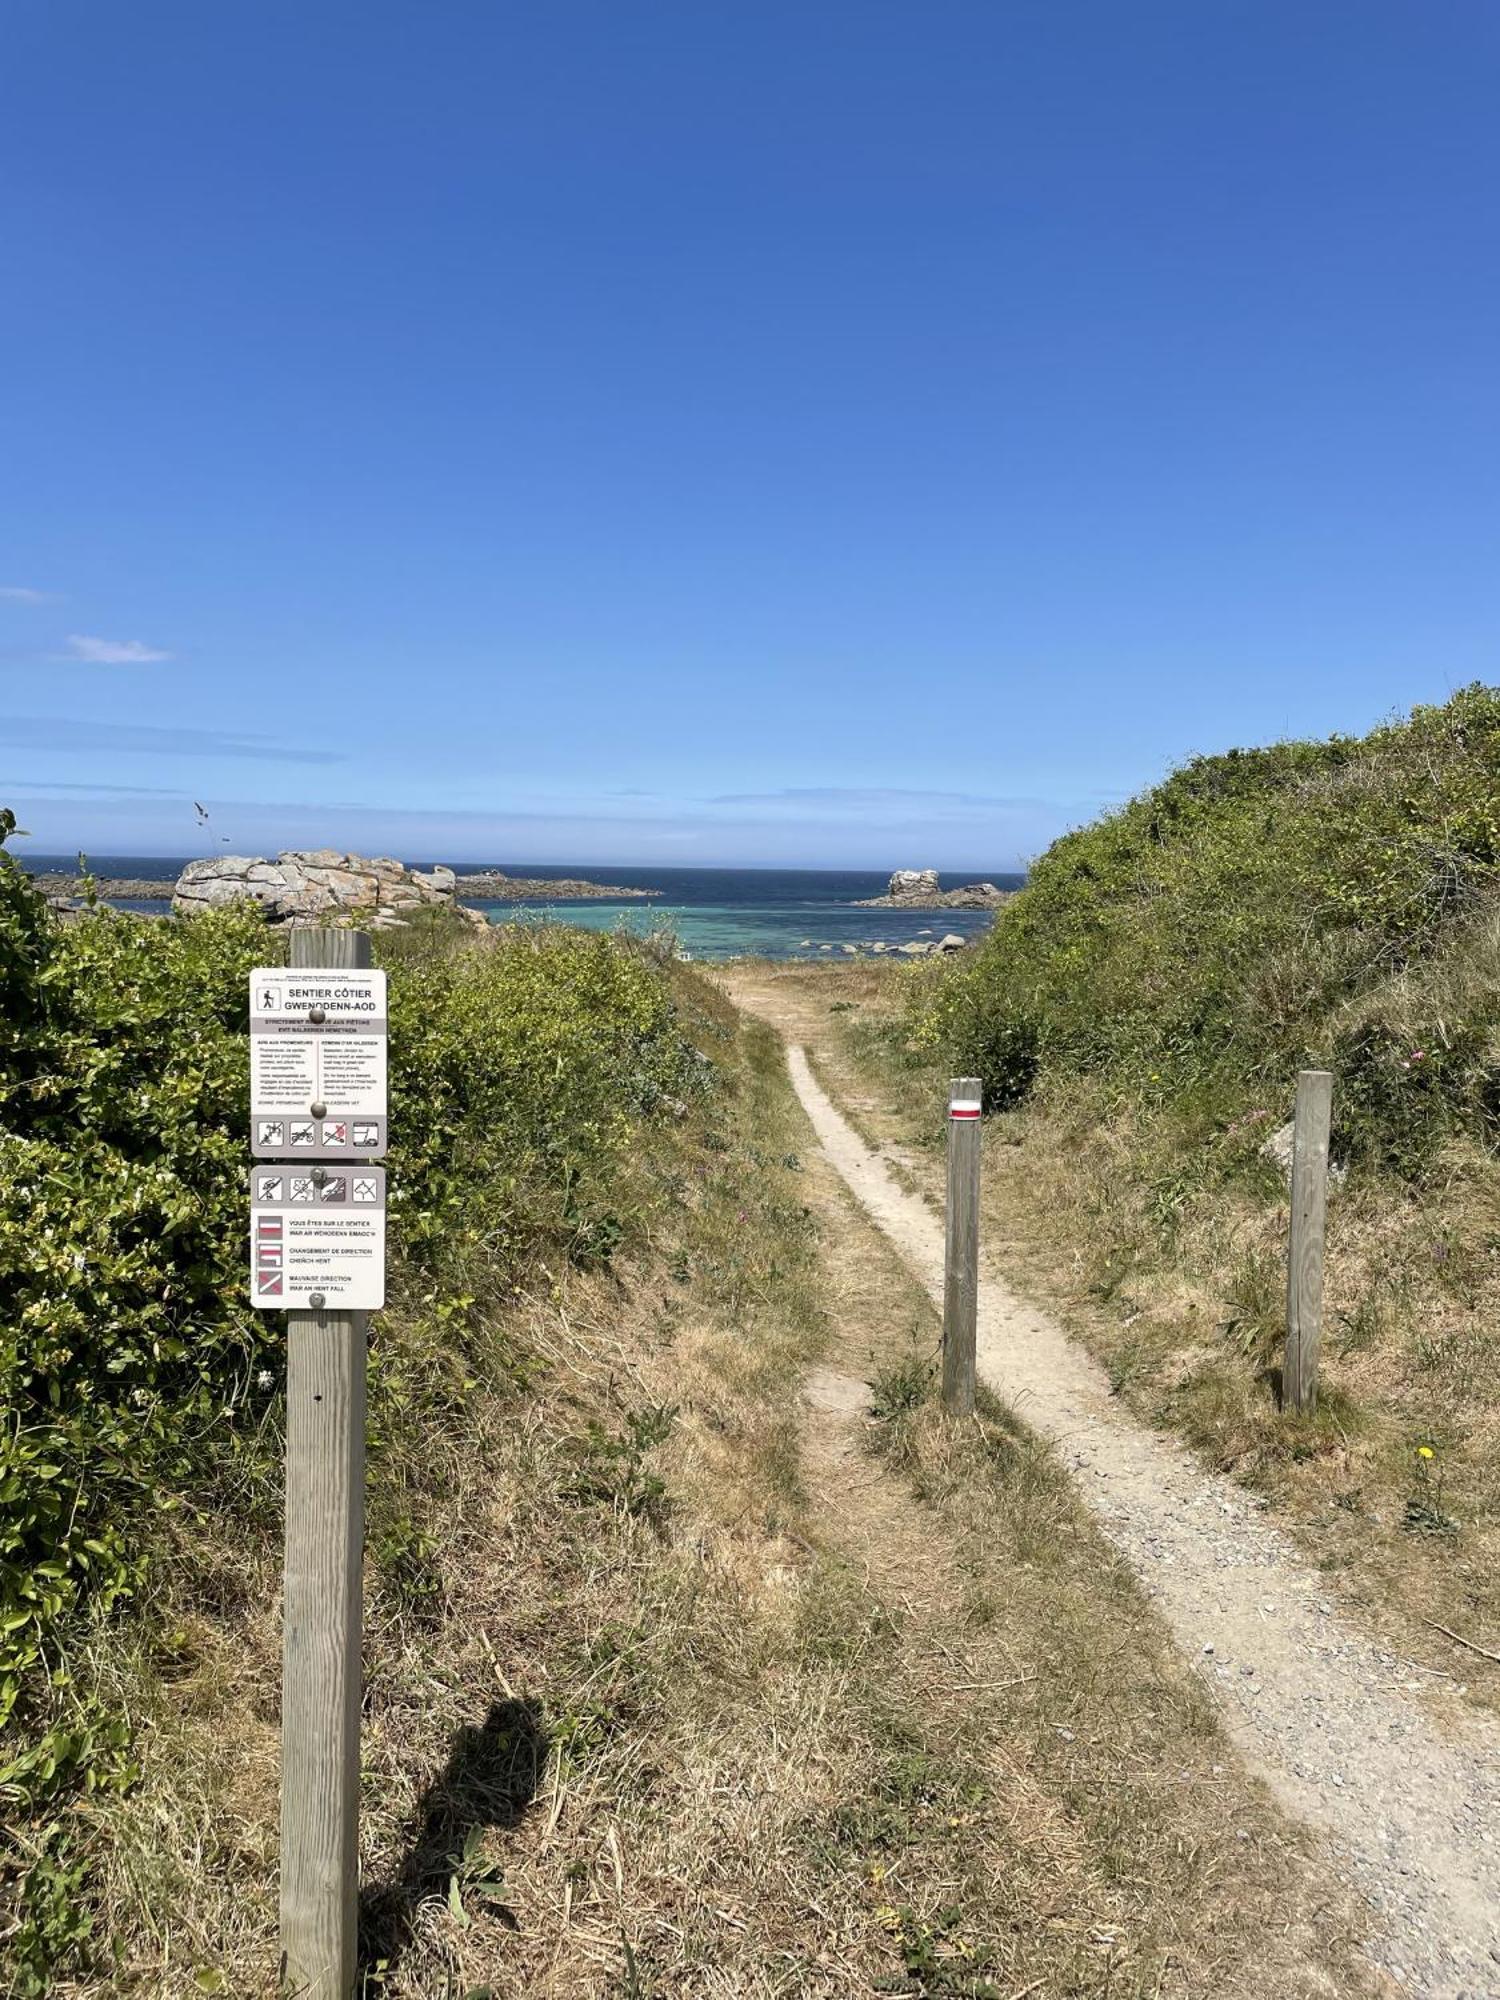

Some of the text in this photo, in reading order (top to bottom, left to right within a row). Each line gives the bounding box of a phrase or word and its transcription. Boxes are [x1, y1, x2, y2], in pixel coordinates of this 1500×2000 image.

[288, 987, 372, 998] SENTIER CÔTIER
[284, 1001, 376, 1011] GWENODENN-AOD
